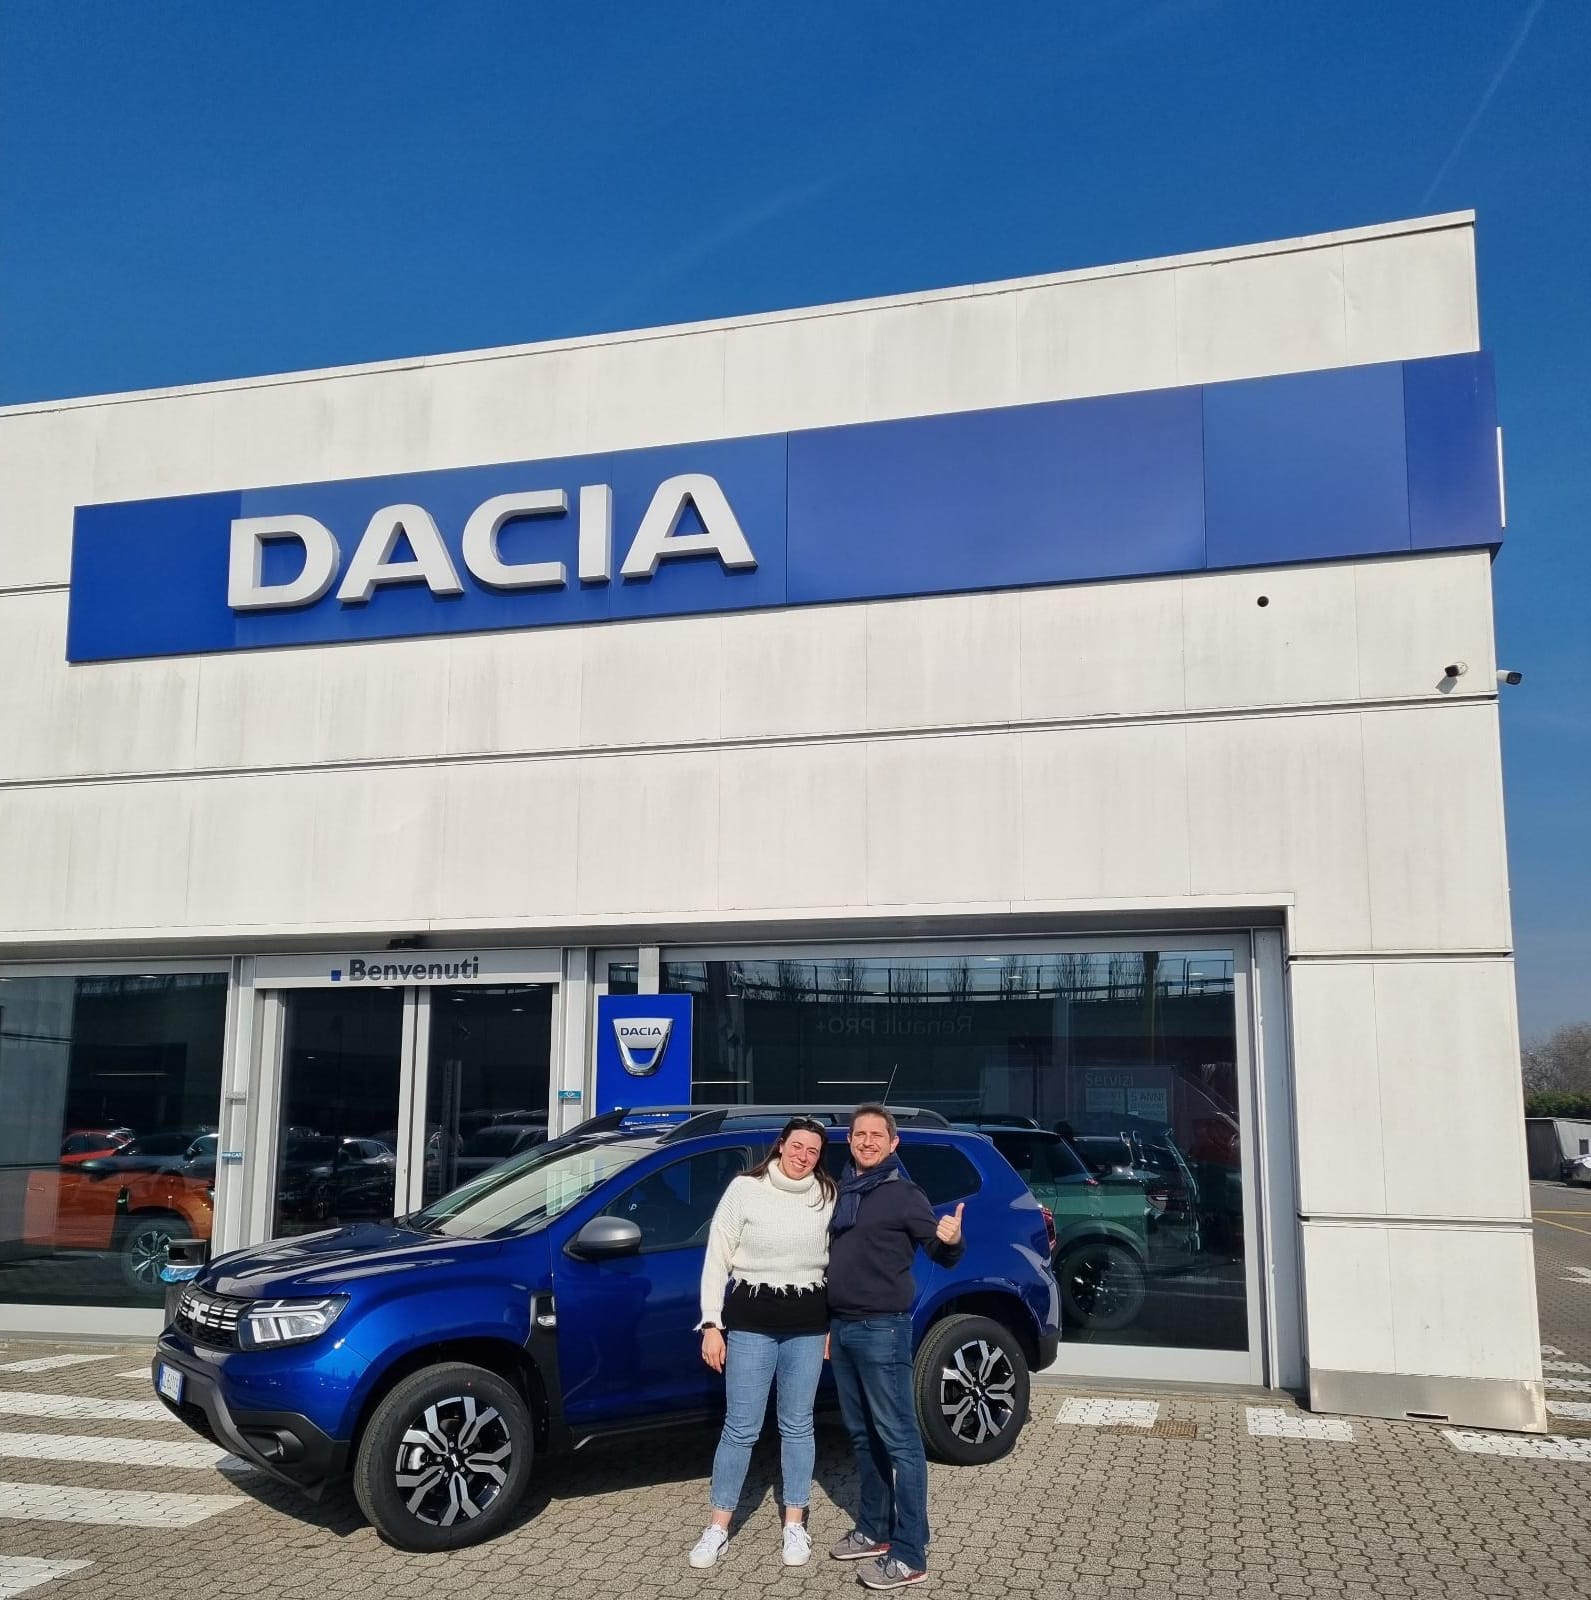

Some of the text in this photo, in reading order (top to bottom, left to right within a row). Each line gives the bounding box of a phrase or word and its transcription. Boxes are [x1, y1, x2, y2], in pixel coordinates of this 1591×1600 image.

[228, 473, 758, 610] DACIA
[349, 956, 479, 981] Benvenuti
[620, 1027, 662, 1036] DACIA
[1084, 1071, 1134, 1087] Servizi
